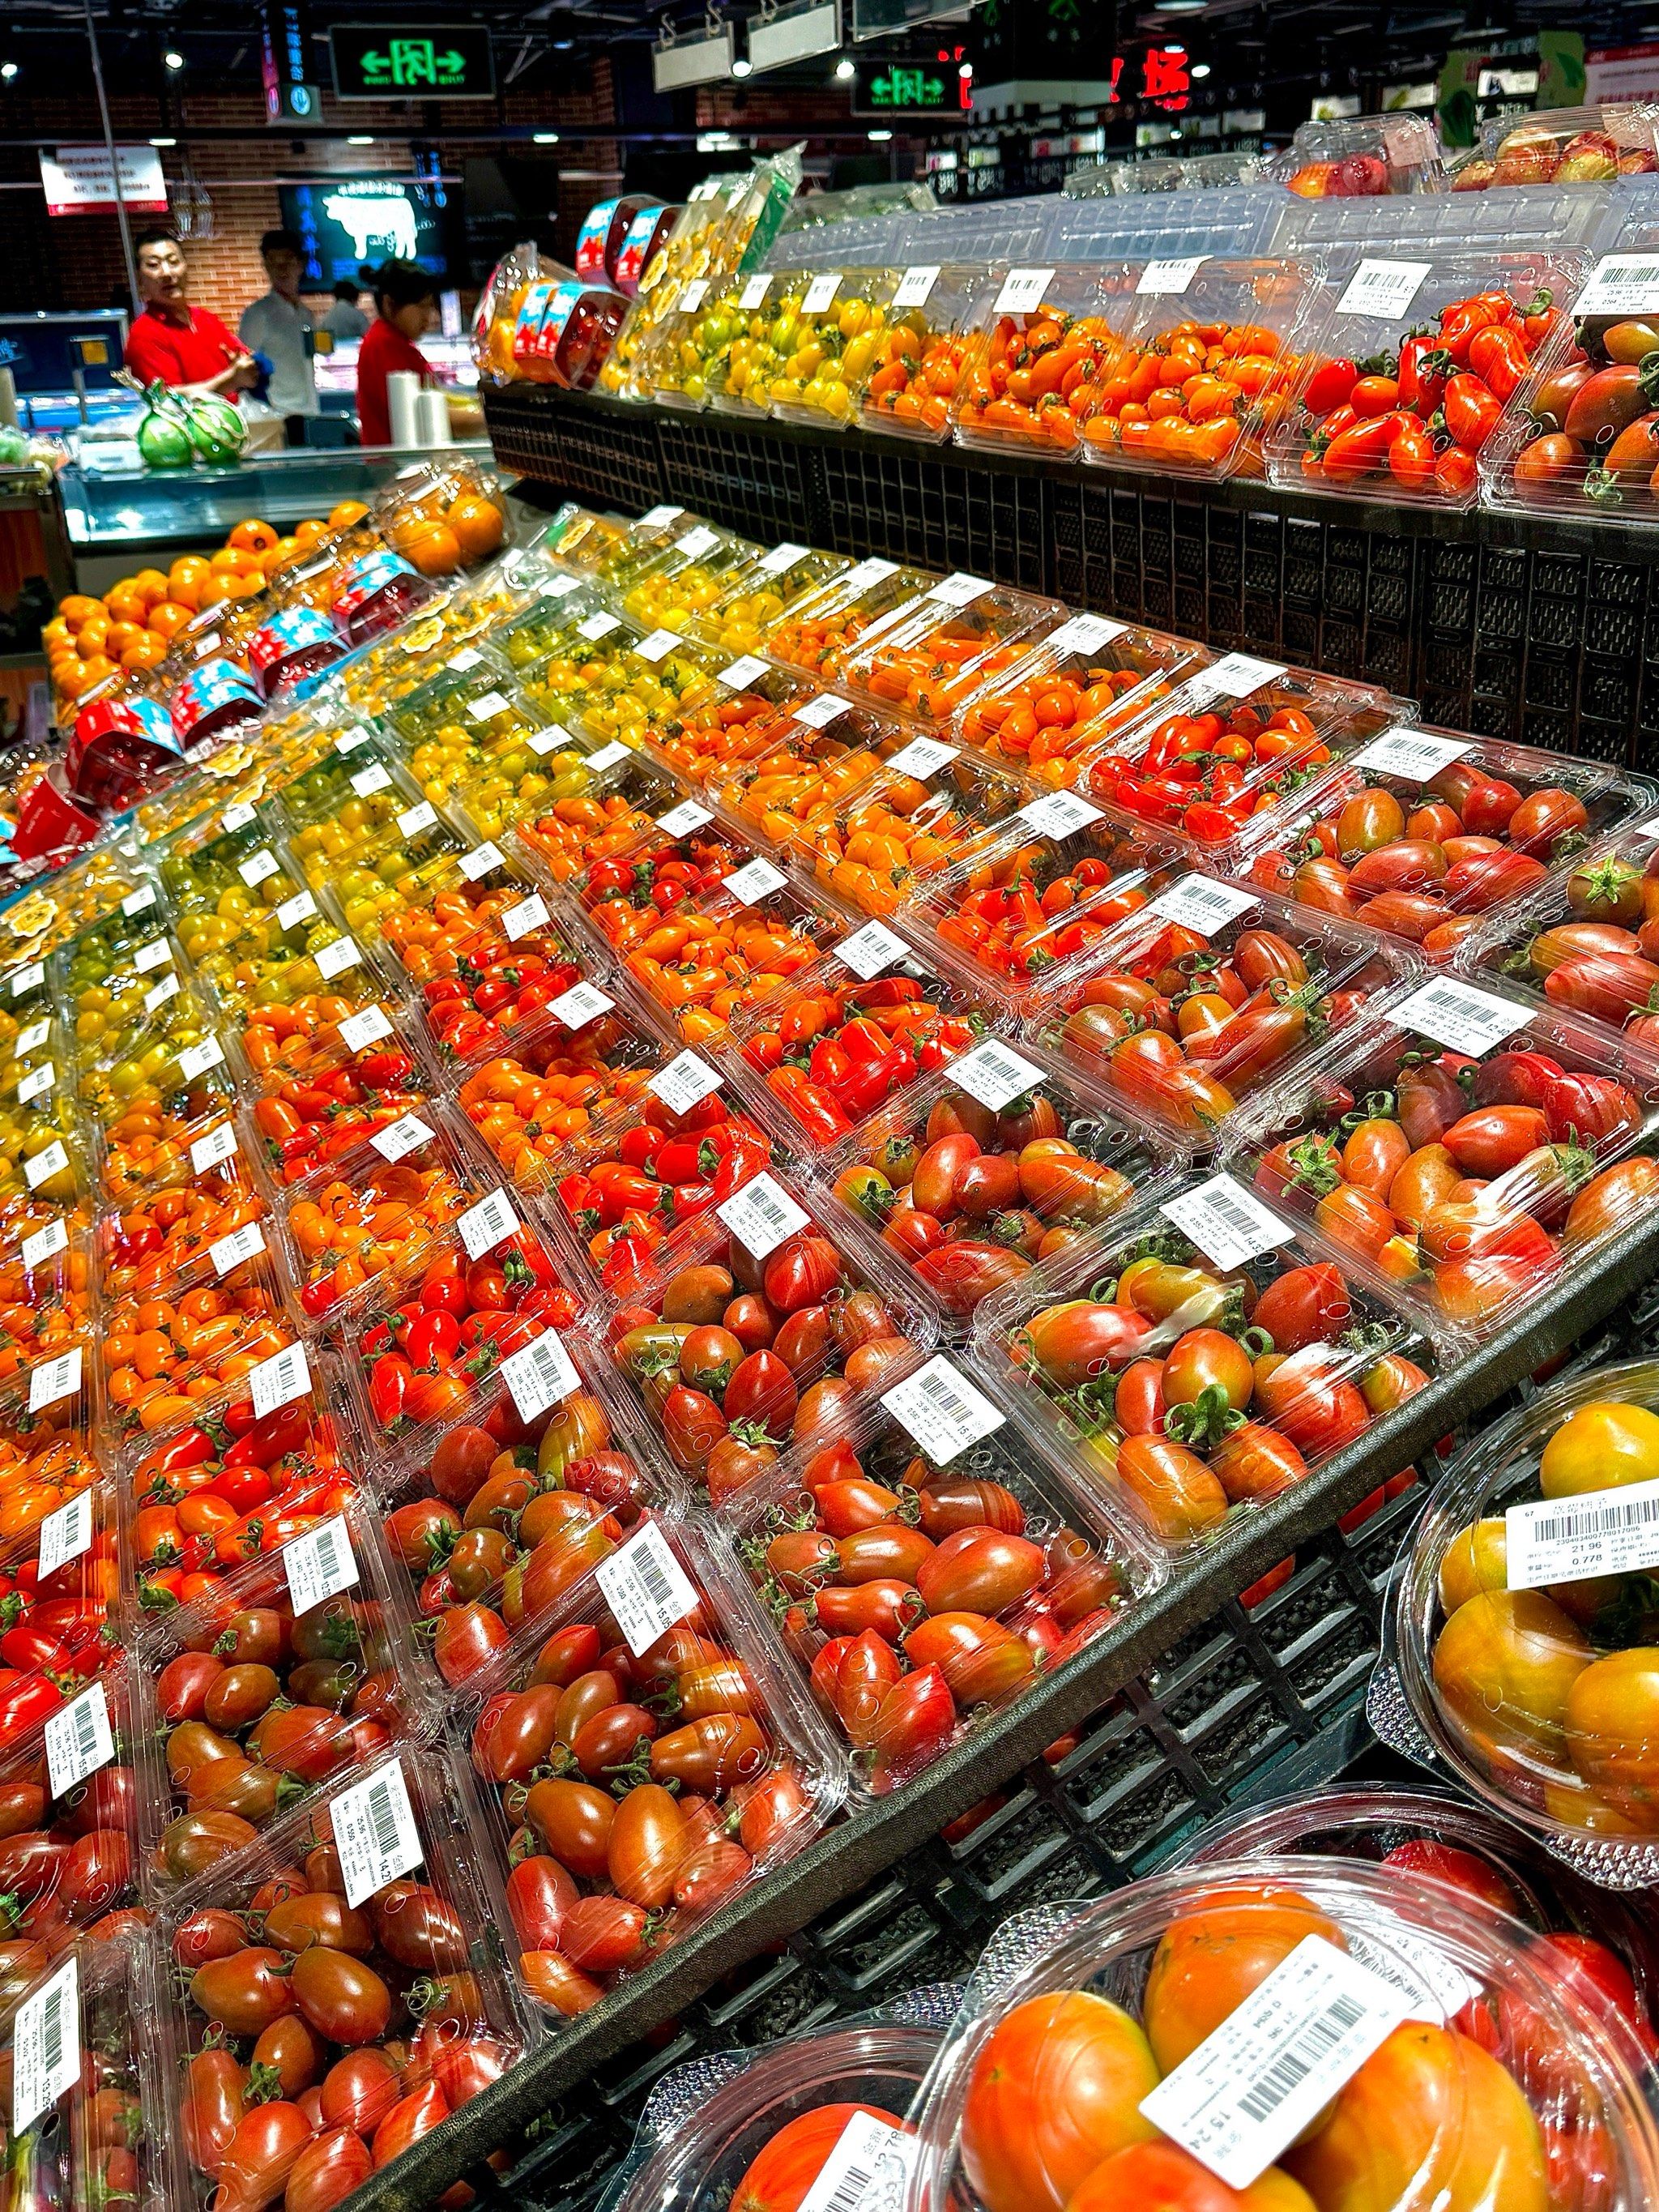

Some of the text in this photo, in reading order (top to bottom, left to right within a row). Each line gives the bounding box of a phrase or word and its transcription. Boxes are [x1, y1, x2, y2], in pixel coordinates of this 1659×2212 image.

[1243, 1236, 1265, 1253] 14.32
[956, 1424, 977, 1444] 15.10
[1524, 1510, 1534, 1518] 67
[1572, 1553, 1602, 1565] 0.778
[655, 1605, 672, 1630] 15.05
[377, 1857, 392, 1885] 14.27
[41, 2076, 50, 2109] 13.29
